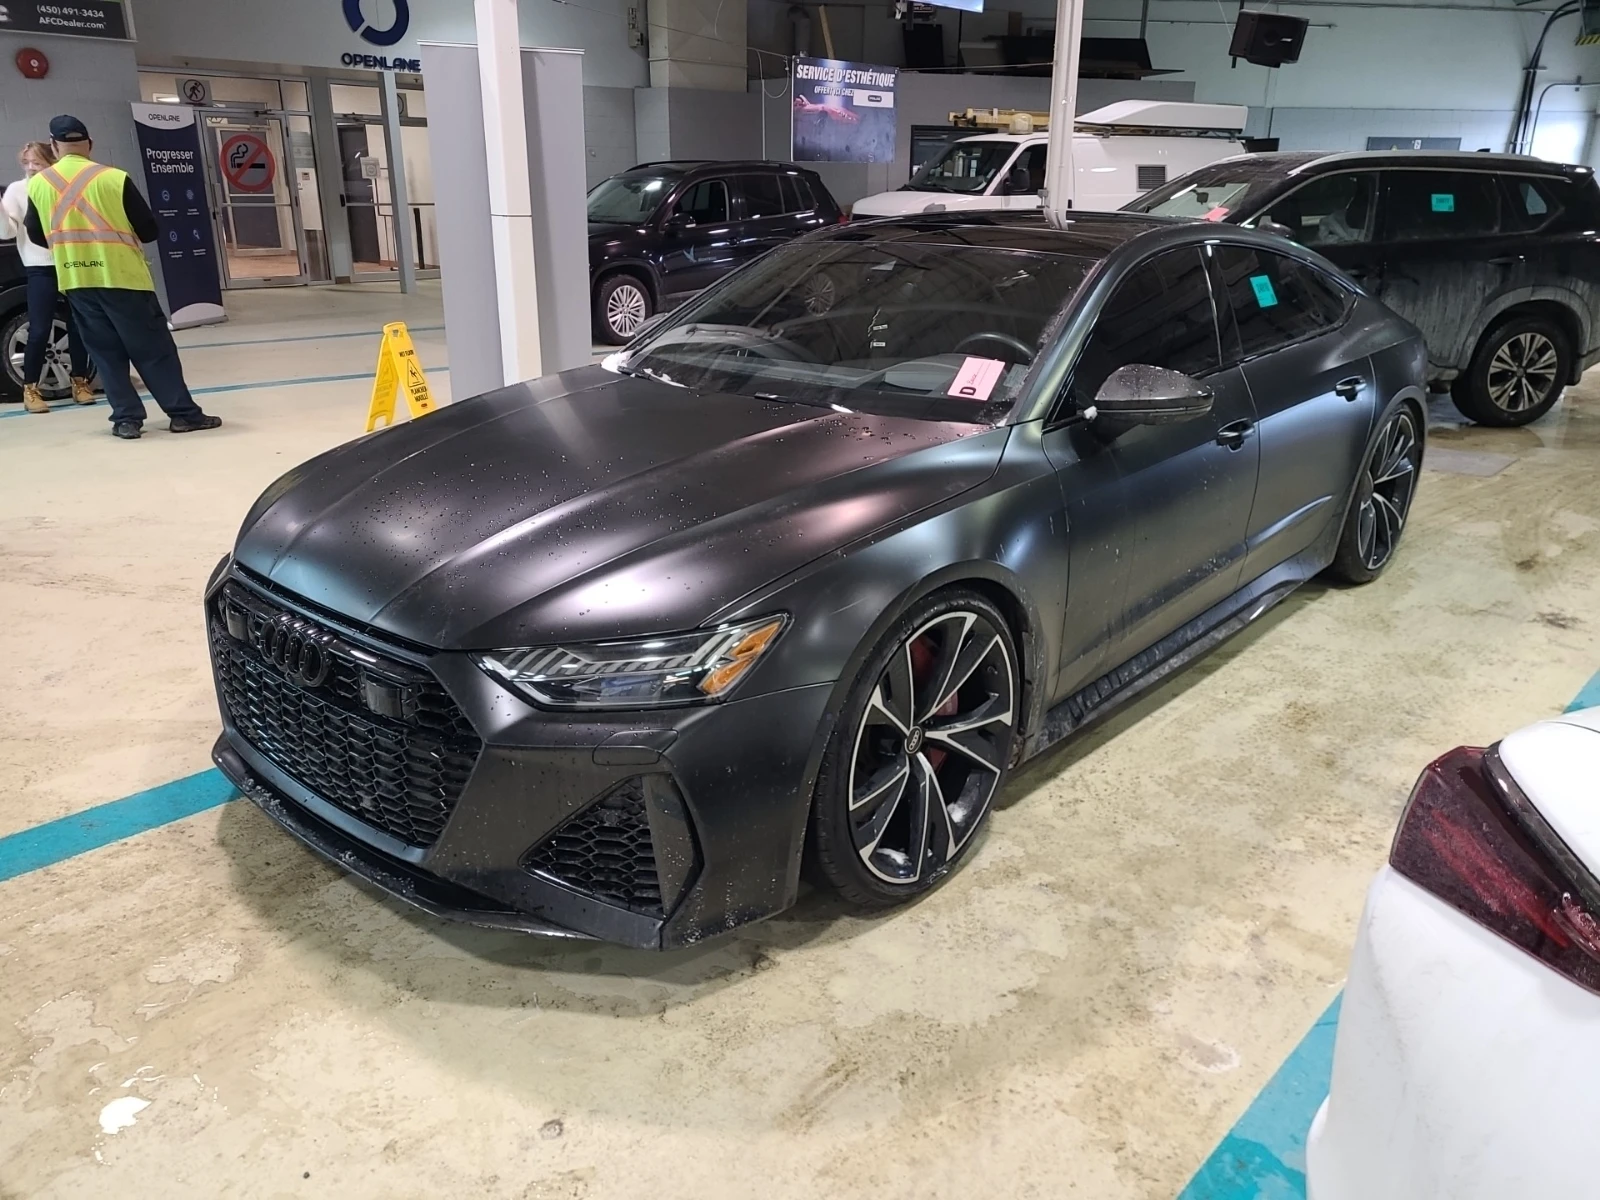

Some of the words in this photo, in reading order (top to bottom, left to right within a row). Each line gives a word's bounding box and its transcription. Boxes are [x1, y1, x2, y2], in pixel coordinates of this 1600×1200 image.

[36, 4, 61, 15] (450)
[62, 7, 104, 18] 491-3434
[39, 16, 105, 29] AFCDealer.com
[341, 52, 421, 72] OPENLANE
[796, 64, 834, 82] SERVICE
[836, 68, 896, 88] D'ESTHÉTIQUE
[148, 113, 181, 122] OPENLANE
[146, 148, 194, 163] Progresser
[151, 162, 194, 174] Ensemble
[959, 386, 976, 396] D
